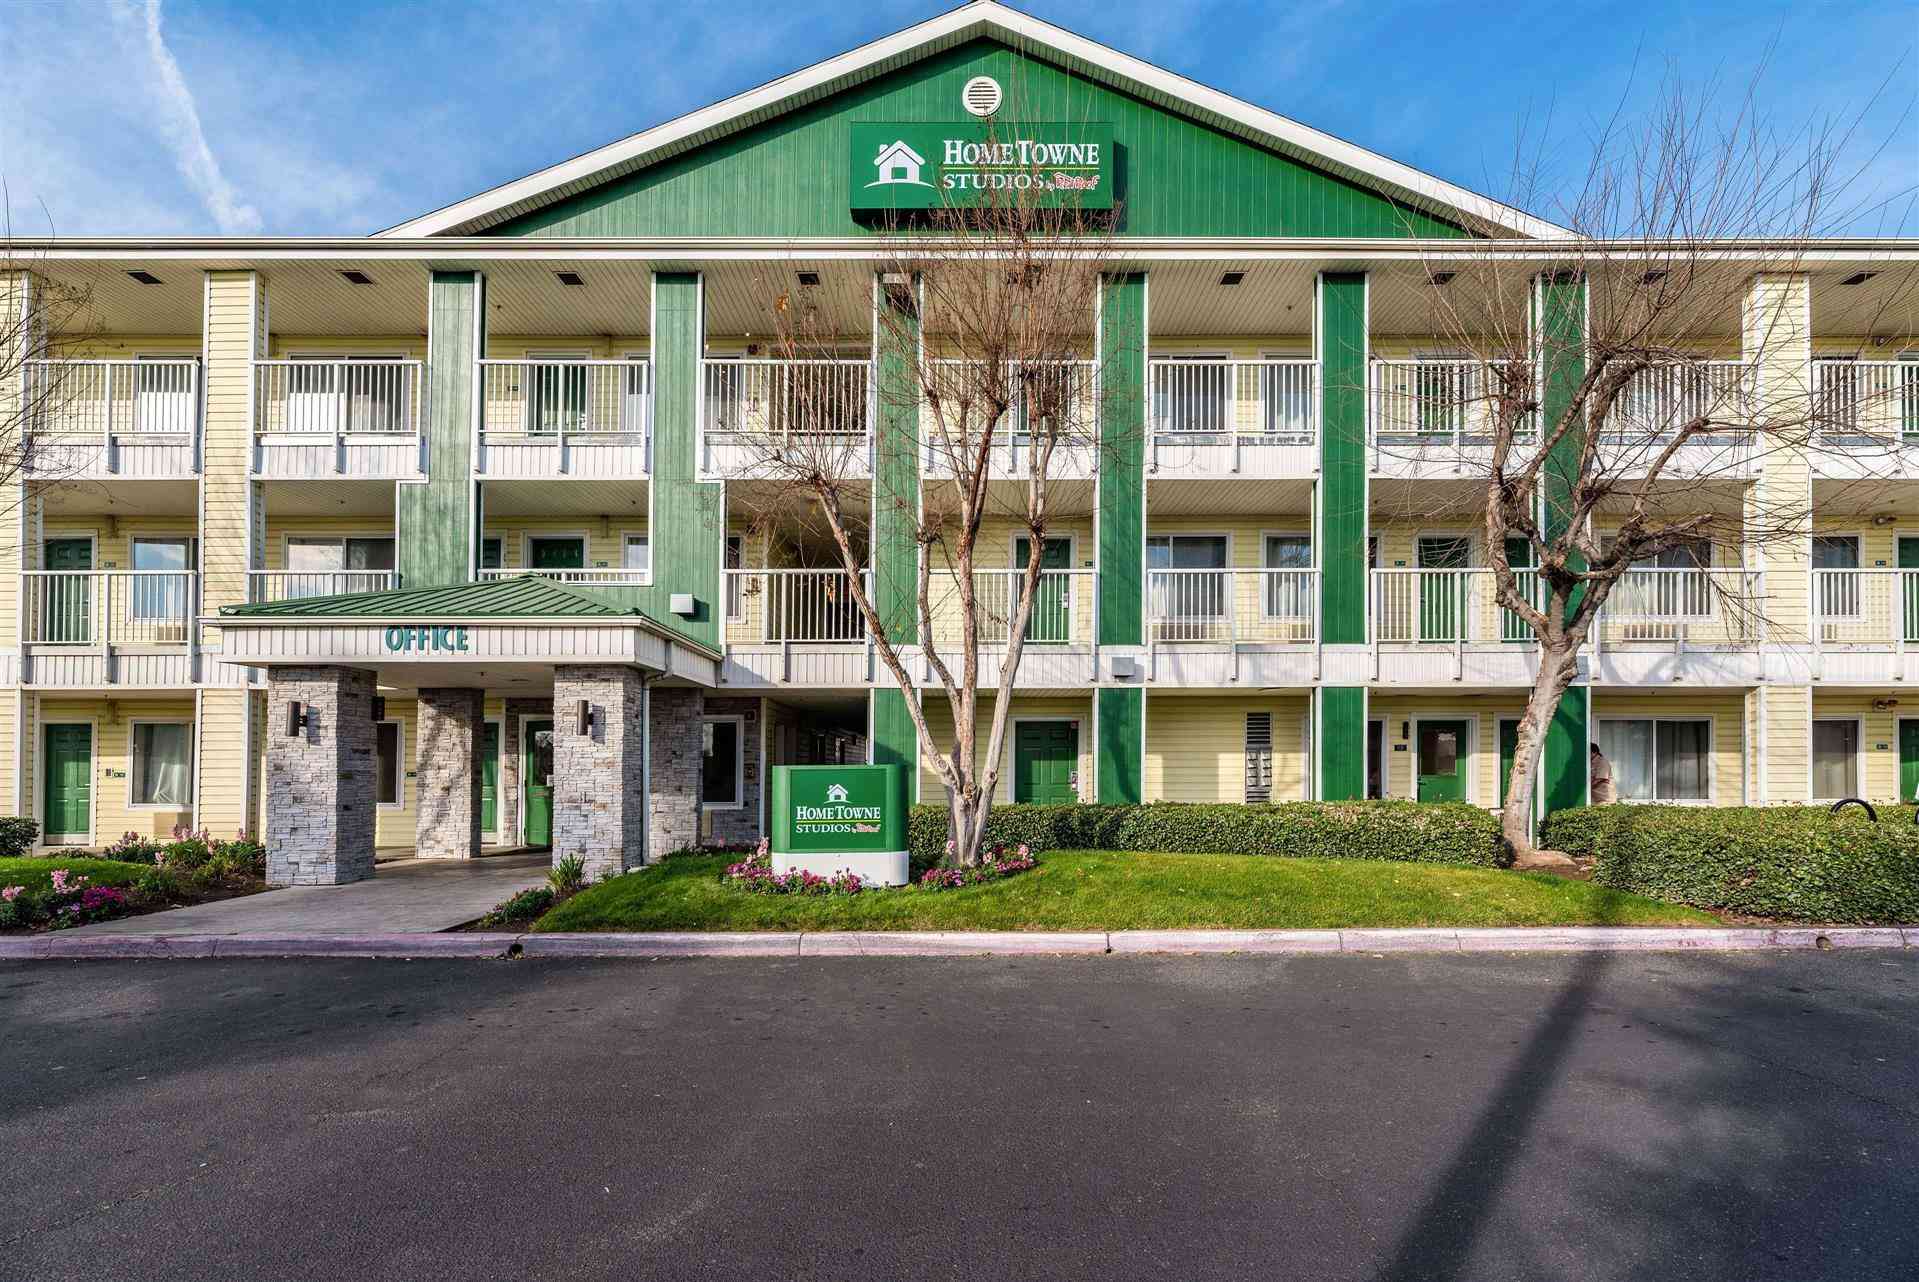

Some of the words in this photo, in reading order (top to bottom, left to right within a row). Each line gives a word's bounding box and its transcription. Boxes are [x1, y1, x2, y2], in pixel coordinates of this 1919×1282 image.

[943, 173, 1044, 189] STUDIOS
[385, 625, 469, 651] OFFICE
[796, 824, 851, 833] STUDIOS
